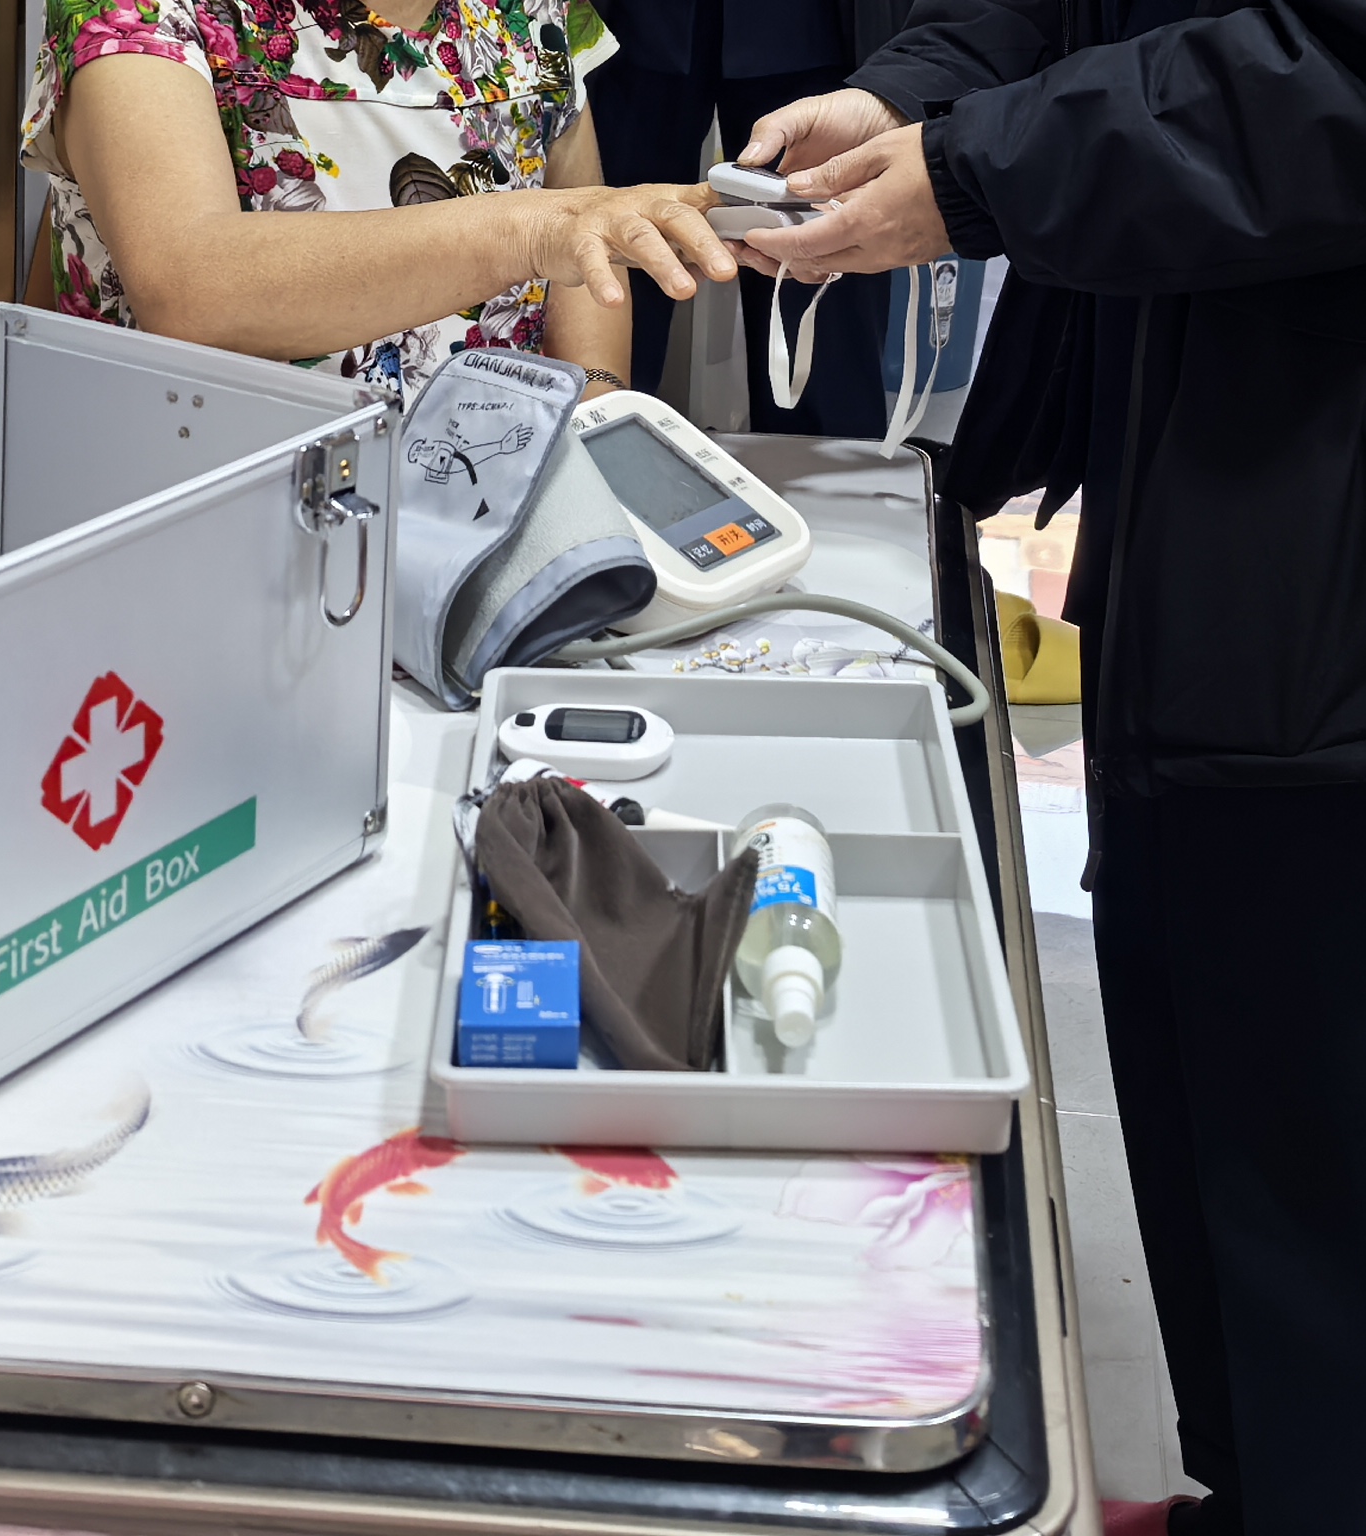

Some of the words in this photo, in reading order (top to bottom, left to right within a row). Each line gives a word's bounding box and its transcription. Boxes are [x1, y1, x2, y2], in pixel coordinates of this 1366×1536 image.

[745, 518, 768, 532] 时间
[77, 875, 128, 941] Aid
[144, 845, 201, 901] Box
